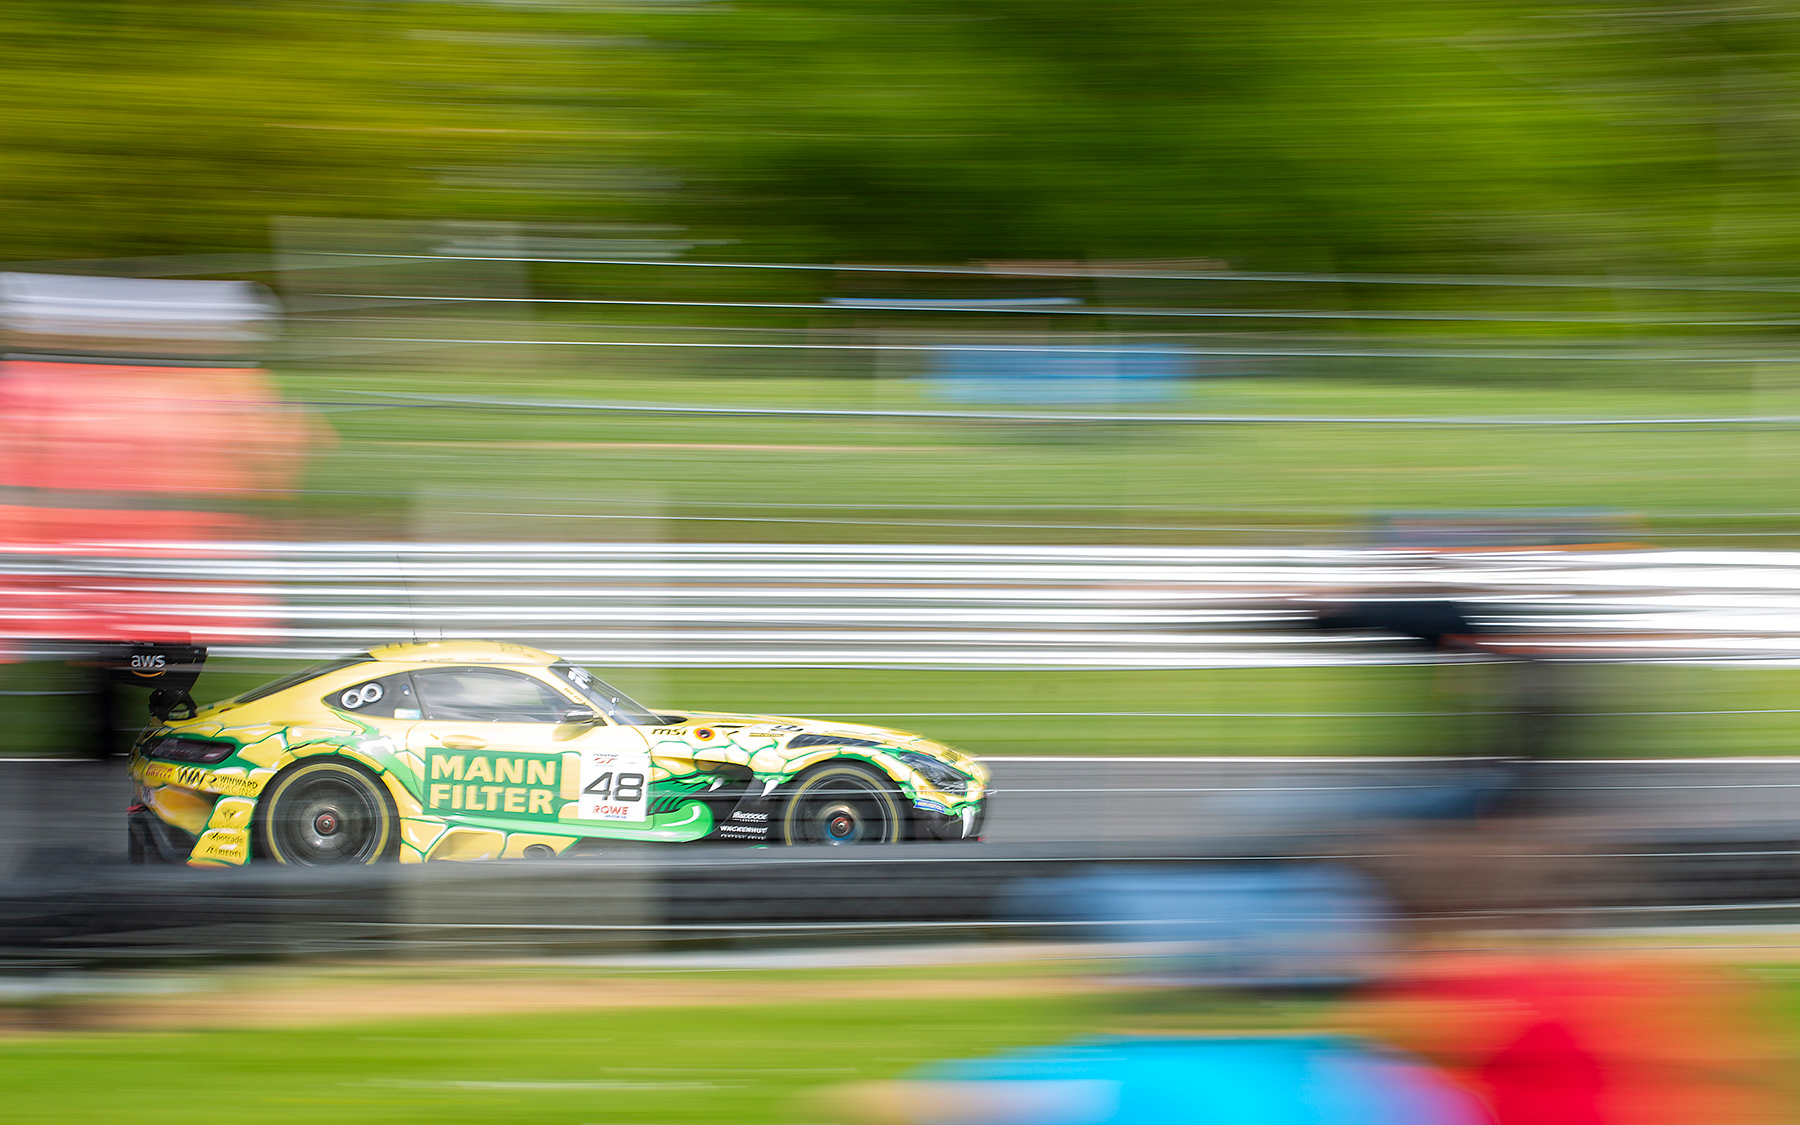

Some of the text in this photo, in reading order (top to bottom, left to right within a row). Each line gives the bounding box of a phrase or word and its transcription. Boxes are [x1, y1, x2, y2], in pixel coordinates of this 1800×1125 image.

[131, 654, 166, 668] aws
[651, 728, 687, 736] msi
[430, 754, 557, 786] MANN
[220, 775, 258, 789] WINWARD
[582, 772, 644, 802] 48
[218, 783, 257, 797] RACING
[429, 783, 555, 815] FILTER
[592, 805, 629, 816] ROWE
[720, 825, 768, 834] WACKENHUT
